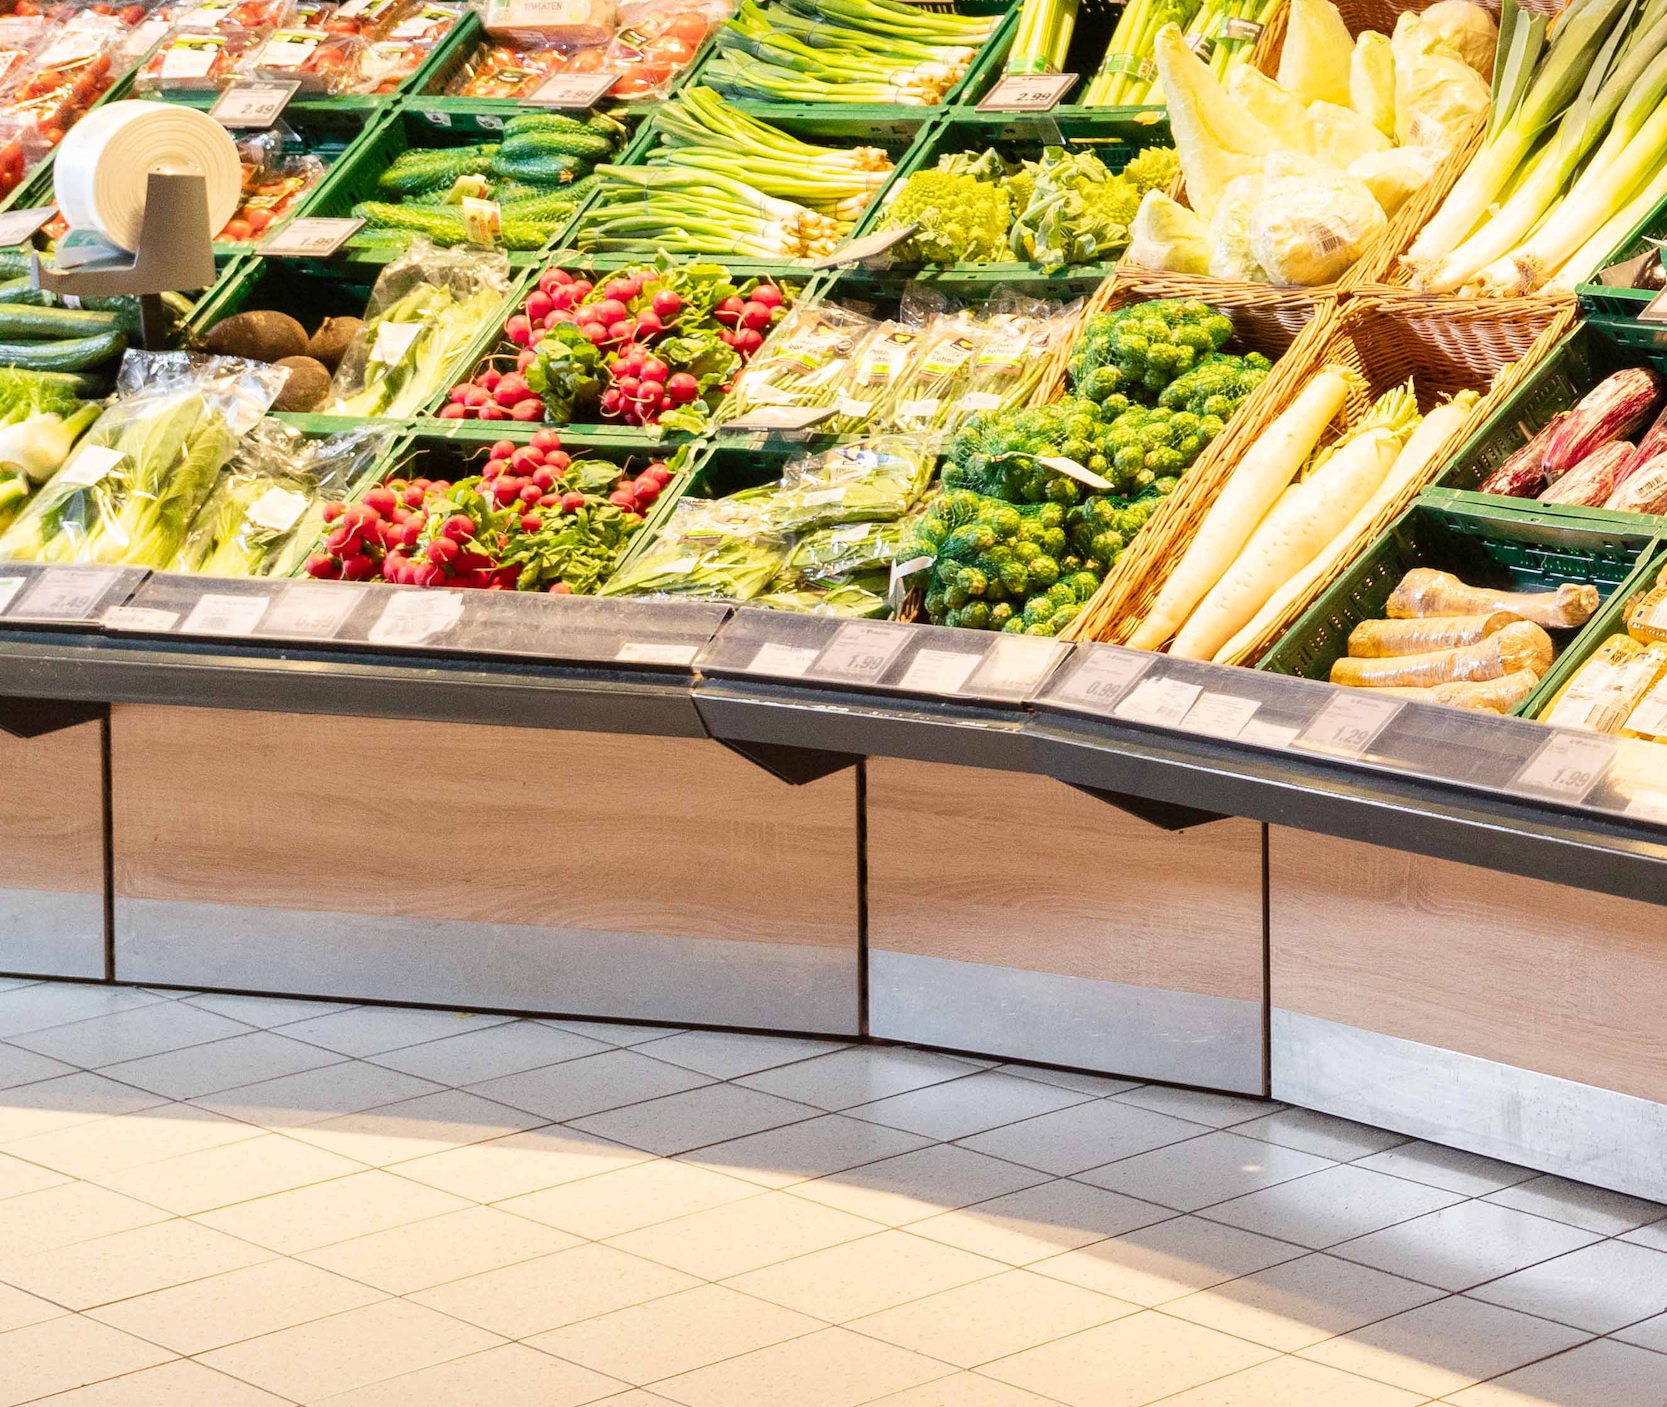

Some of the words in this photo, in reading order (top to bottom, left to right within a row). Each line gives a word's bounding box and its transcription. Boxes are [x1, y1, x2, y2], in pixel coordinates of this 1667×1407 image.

[1015, 92, 1051, 102] 2.99
[846, 654, 883, 671] 1.99
[1086, 681, 1122, 699] 0.99
[1332, 727, 1370, 745] 1.29
[1551, 768, 1592, 788] 1.99
